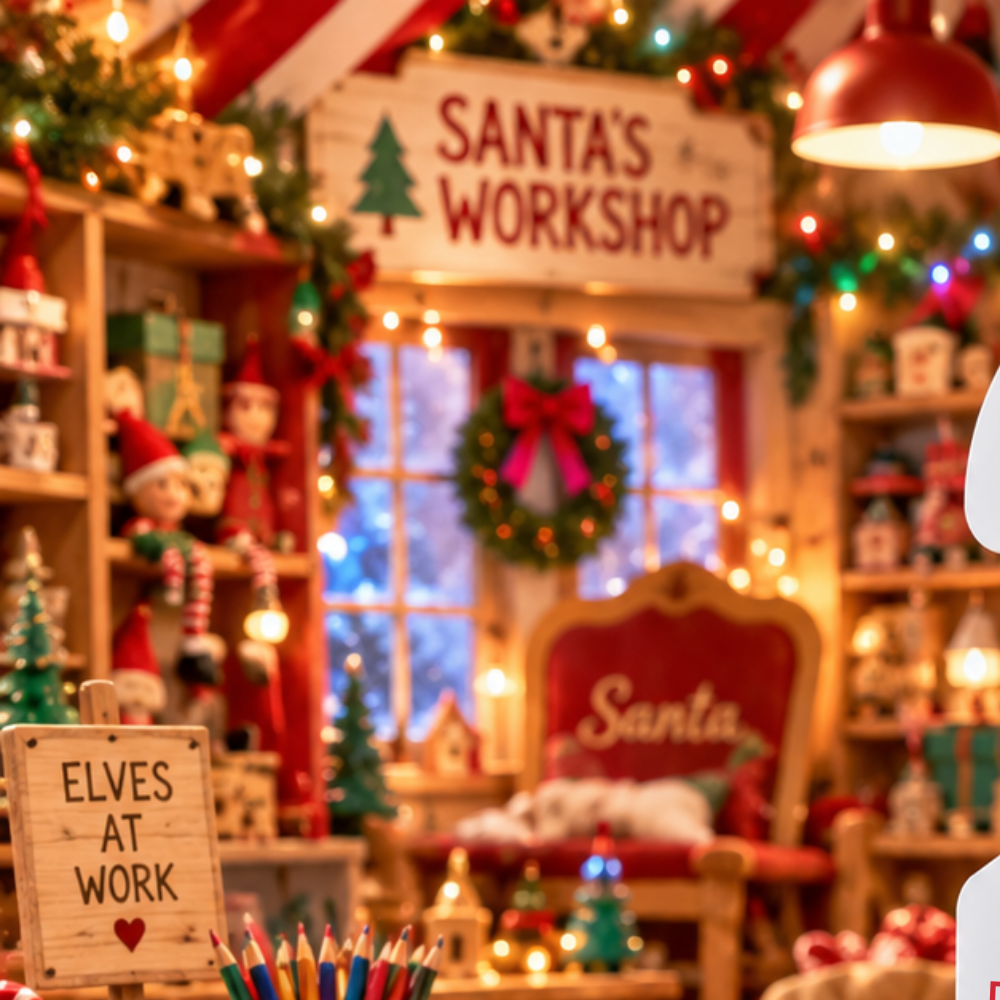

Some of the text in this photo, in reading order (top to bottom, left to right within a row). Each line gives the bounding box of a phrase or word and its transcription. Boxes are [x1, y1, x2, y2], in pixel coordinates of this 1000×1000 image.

[437, 93, 652, 179] SANTA'S
[437, 175, 732, 260] WORKSHOP
[576, 672, 742, 750] Santa
[61, 761, 174, 804] ELVES
[100, 813, 142, 853] AT
[74, 862, 179, 906] WORK
